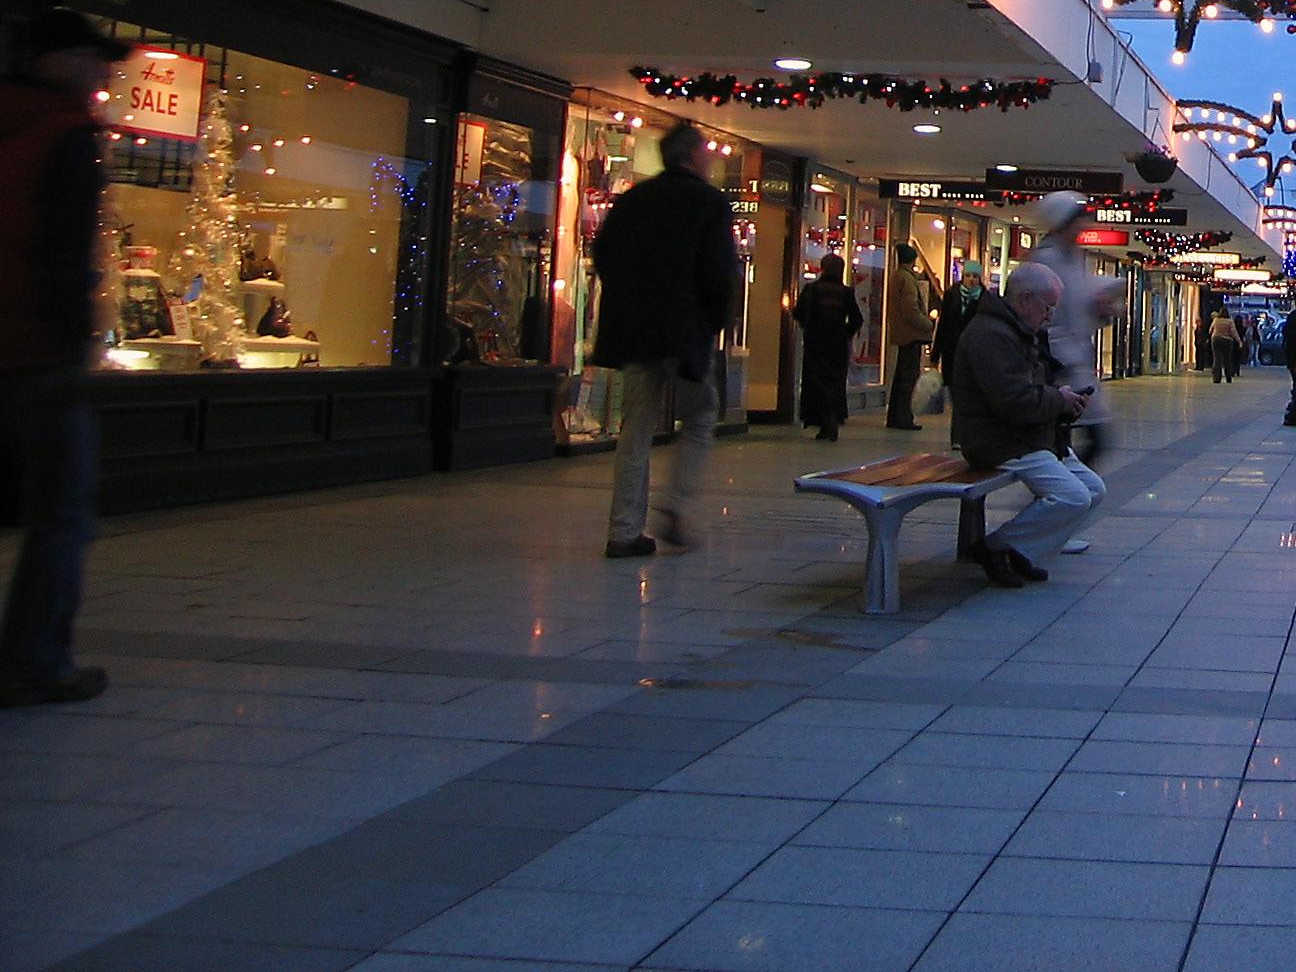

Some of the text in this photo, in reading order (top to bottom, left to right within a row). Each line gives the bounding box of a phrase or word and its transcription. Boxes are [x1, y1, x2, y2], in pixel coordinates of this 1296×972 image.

[130, 86, 178, 116] SALE
[898, 182, 942, 198] BEST
[1025, 177, 1083, 189] CONTOUR
[1096, 209, 1132, 223] BEST
